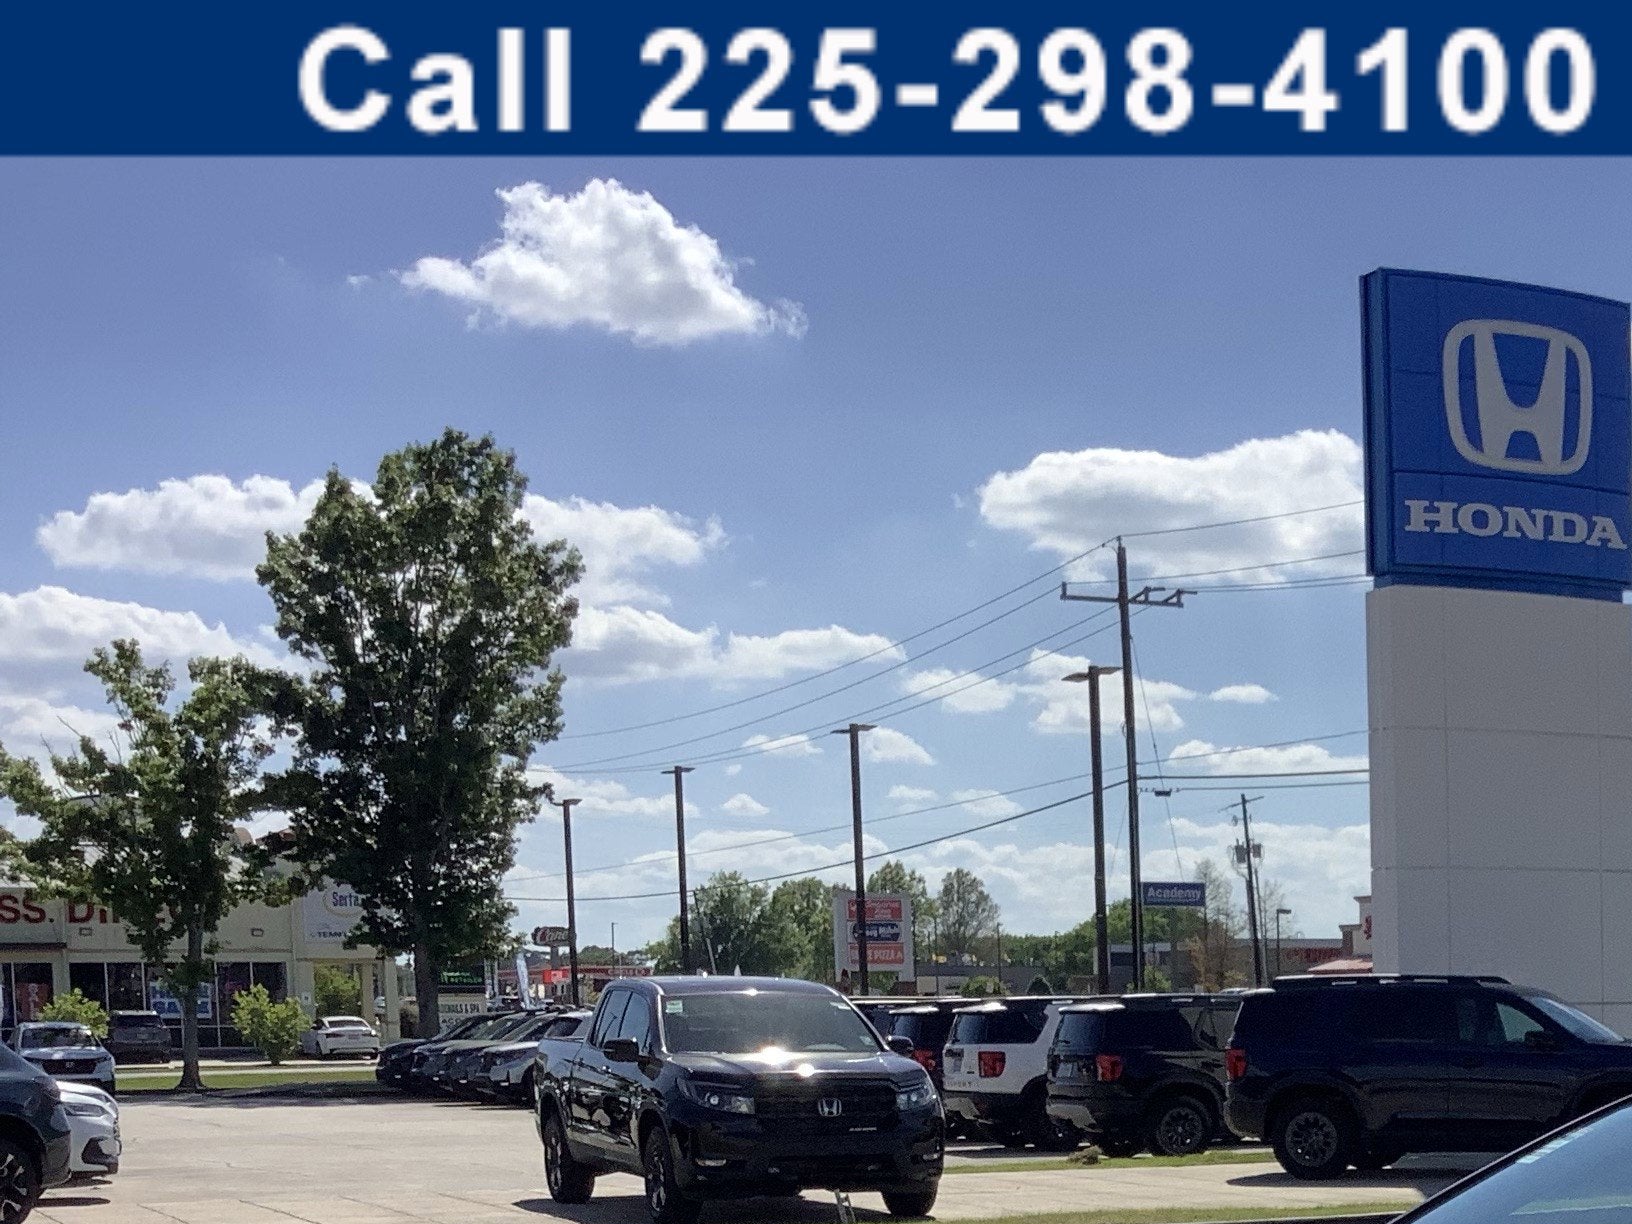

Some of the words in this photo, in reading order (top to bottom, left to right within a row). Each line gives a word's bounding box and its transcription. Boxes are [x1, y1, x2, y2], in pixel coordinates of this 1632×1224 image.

[1404, 499, 1629, 551] HONDA
[332, 891, 360, 907] Serta
[1147, 886, 1202, 900] Academy
[536, 929, 570, 944] Cane
